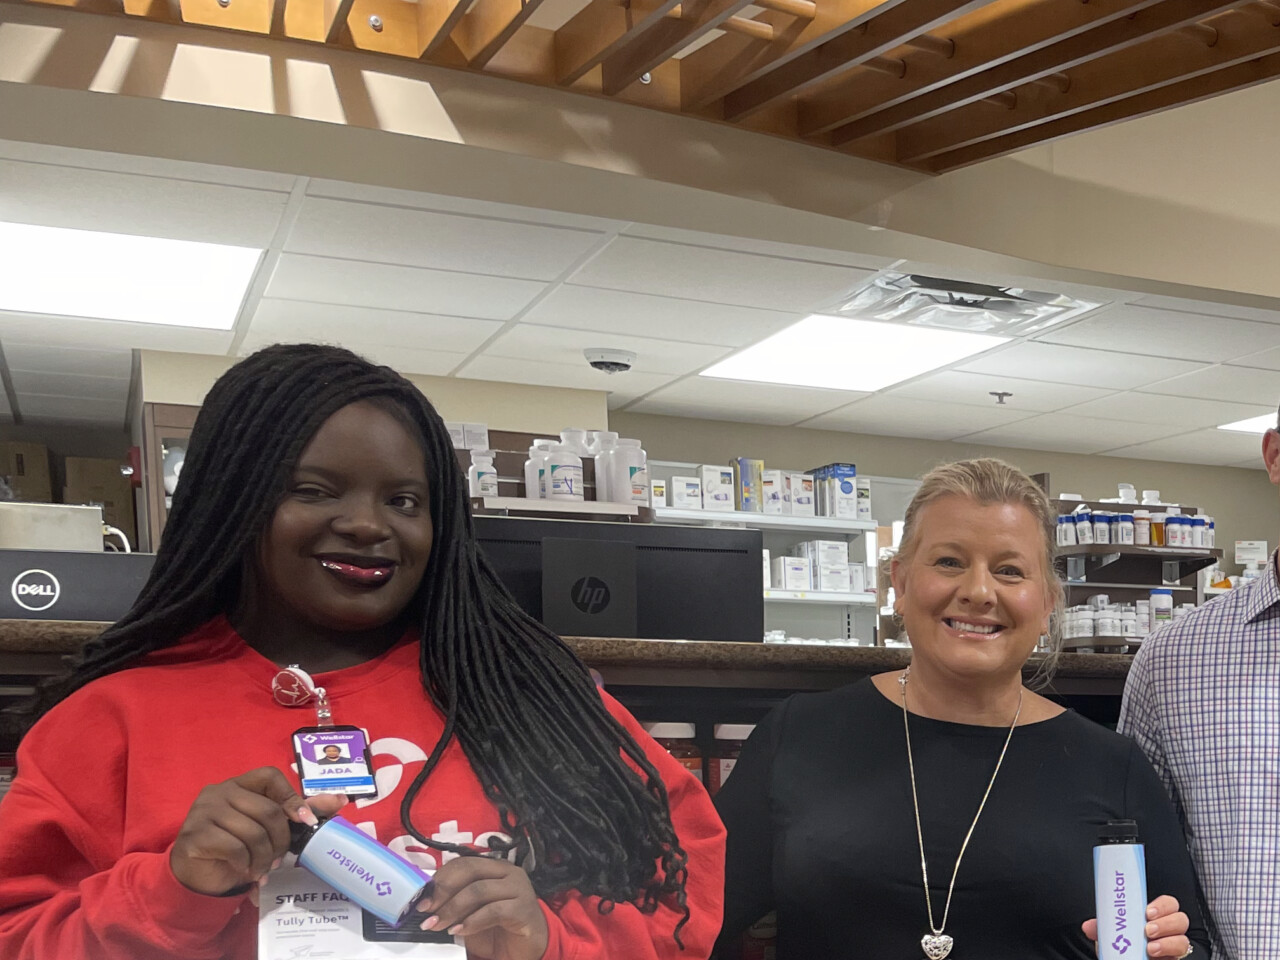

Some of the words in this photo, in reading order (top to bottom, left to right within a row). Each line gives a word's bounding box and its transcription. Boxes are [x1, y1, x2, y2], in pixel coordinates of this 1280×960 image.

[17, 583, 55, 596] DELL
[577, 577, 606, 614] hp
[320, 767, 352, 775] JADA
[327, 847, 375, 886] Wellstar
[276, 892, 319, 905] STAFF
[1113, 870, 1128, 932] Wellstar
[276, 917, 306, 928] Tully
